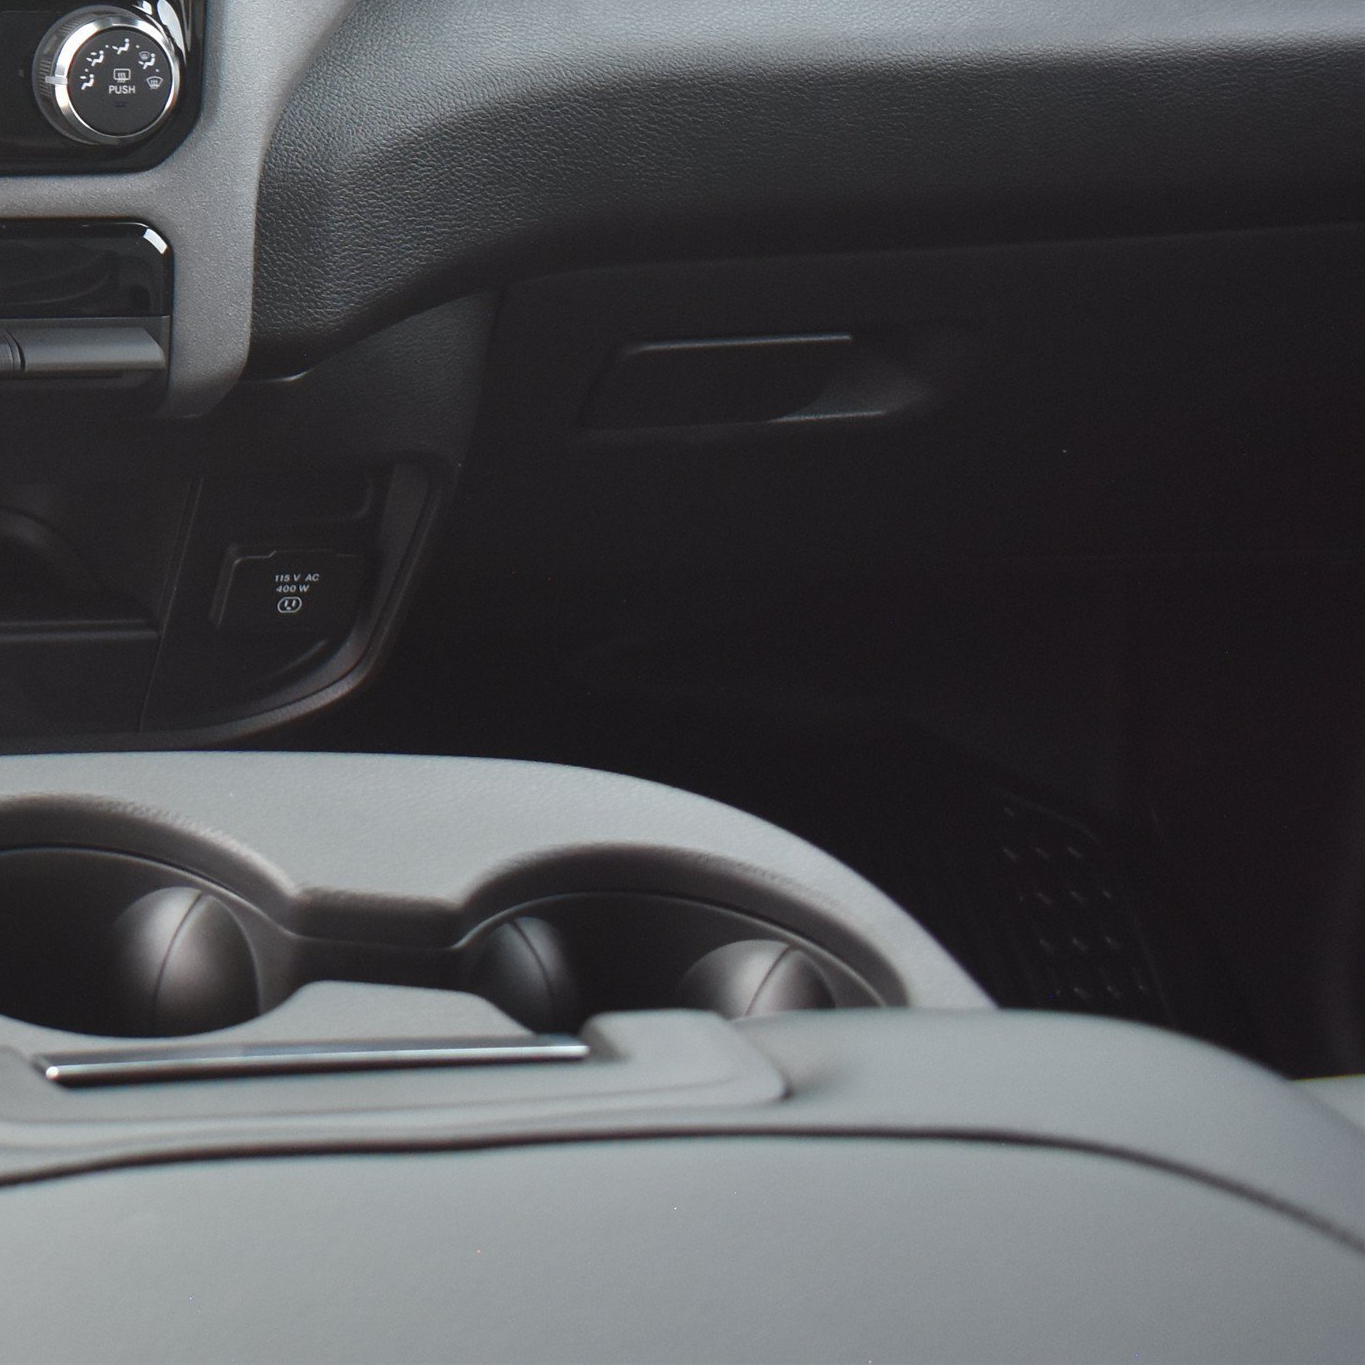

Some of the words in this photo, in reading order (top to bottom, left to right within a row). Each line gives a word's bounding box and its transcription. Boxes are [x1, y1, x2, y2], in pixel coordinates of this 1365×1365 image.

[108, 84, 136, 95] PUSH
[274, 573, 291, 583] 115
[293, 573, 301, 582] V
[304, 573, 320, 583] AC
[276, 584, 297, 593] 400
[299, 584, 310, 593] W
